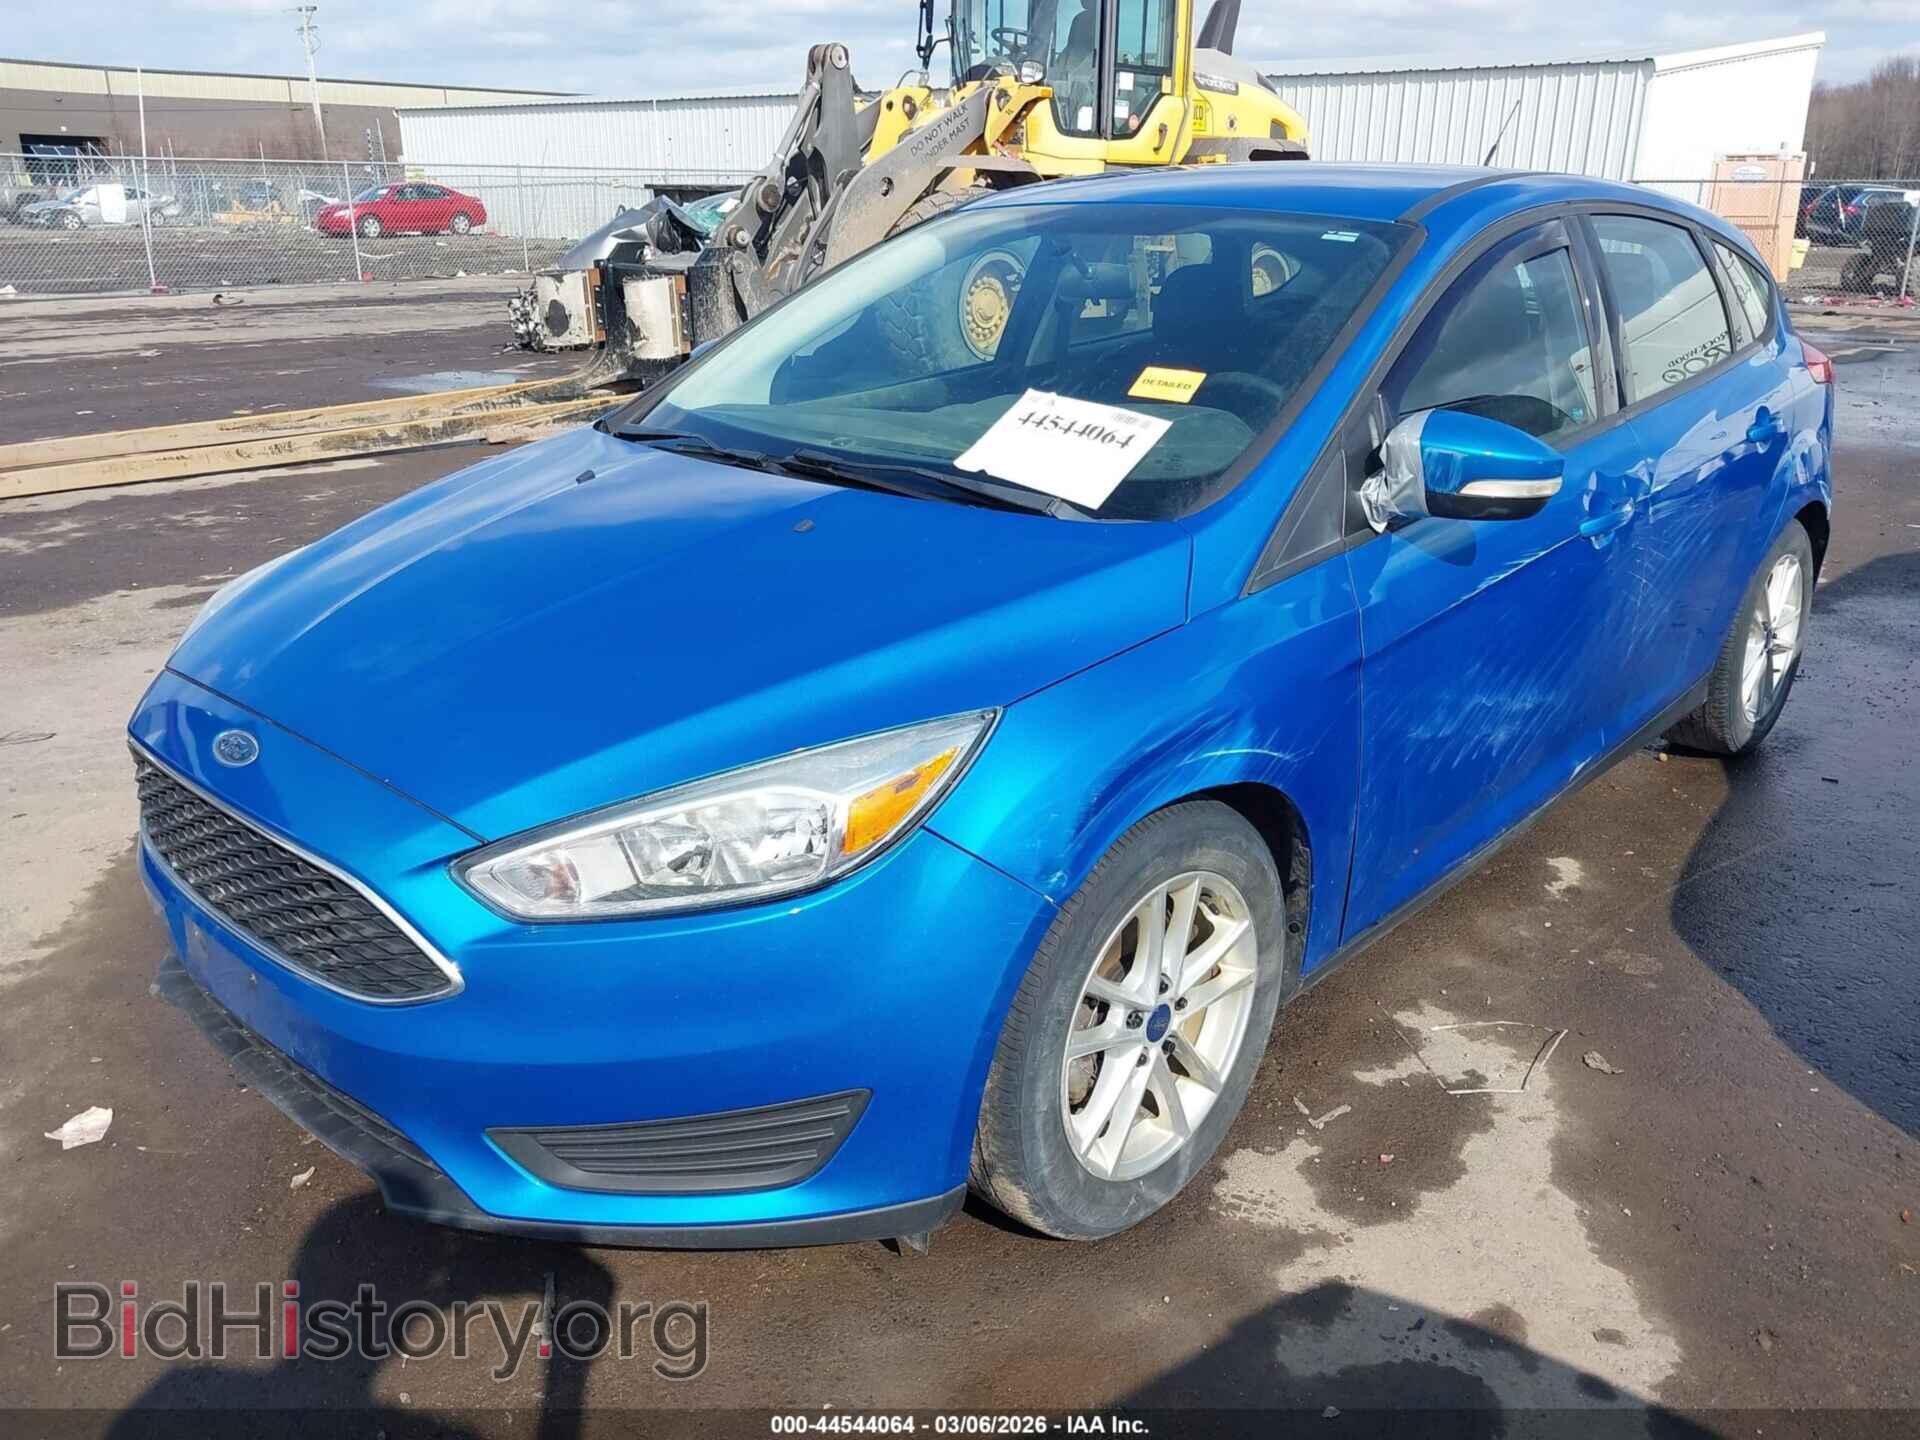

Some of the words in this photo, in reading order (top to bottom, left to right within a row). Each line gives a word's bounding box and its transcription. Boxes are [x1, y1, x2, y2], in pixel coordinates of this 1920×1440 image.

[911, 141, 924, 157] DO
[924, 123, 944, 144] NOT
[944, 103, 969, 126] WALK
[949, 116, 969, 140] MAST
[1142, 378, 1192, 391] DETAILED
[1018, 411, 1136, 448] 44544064
